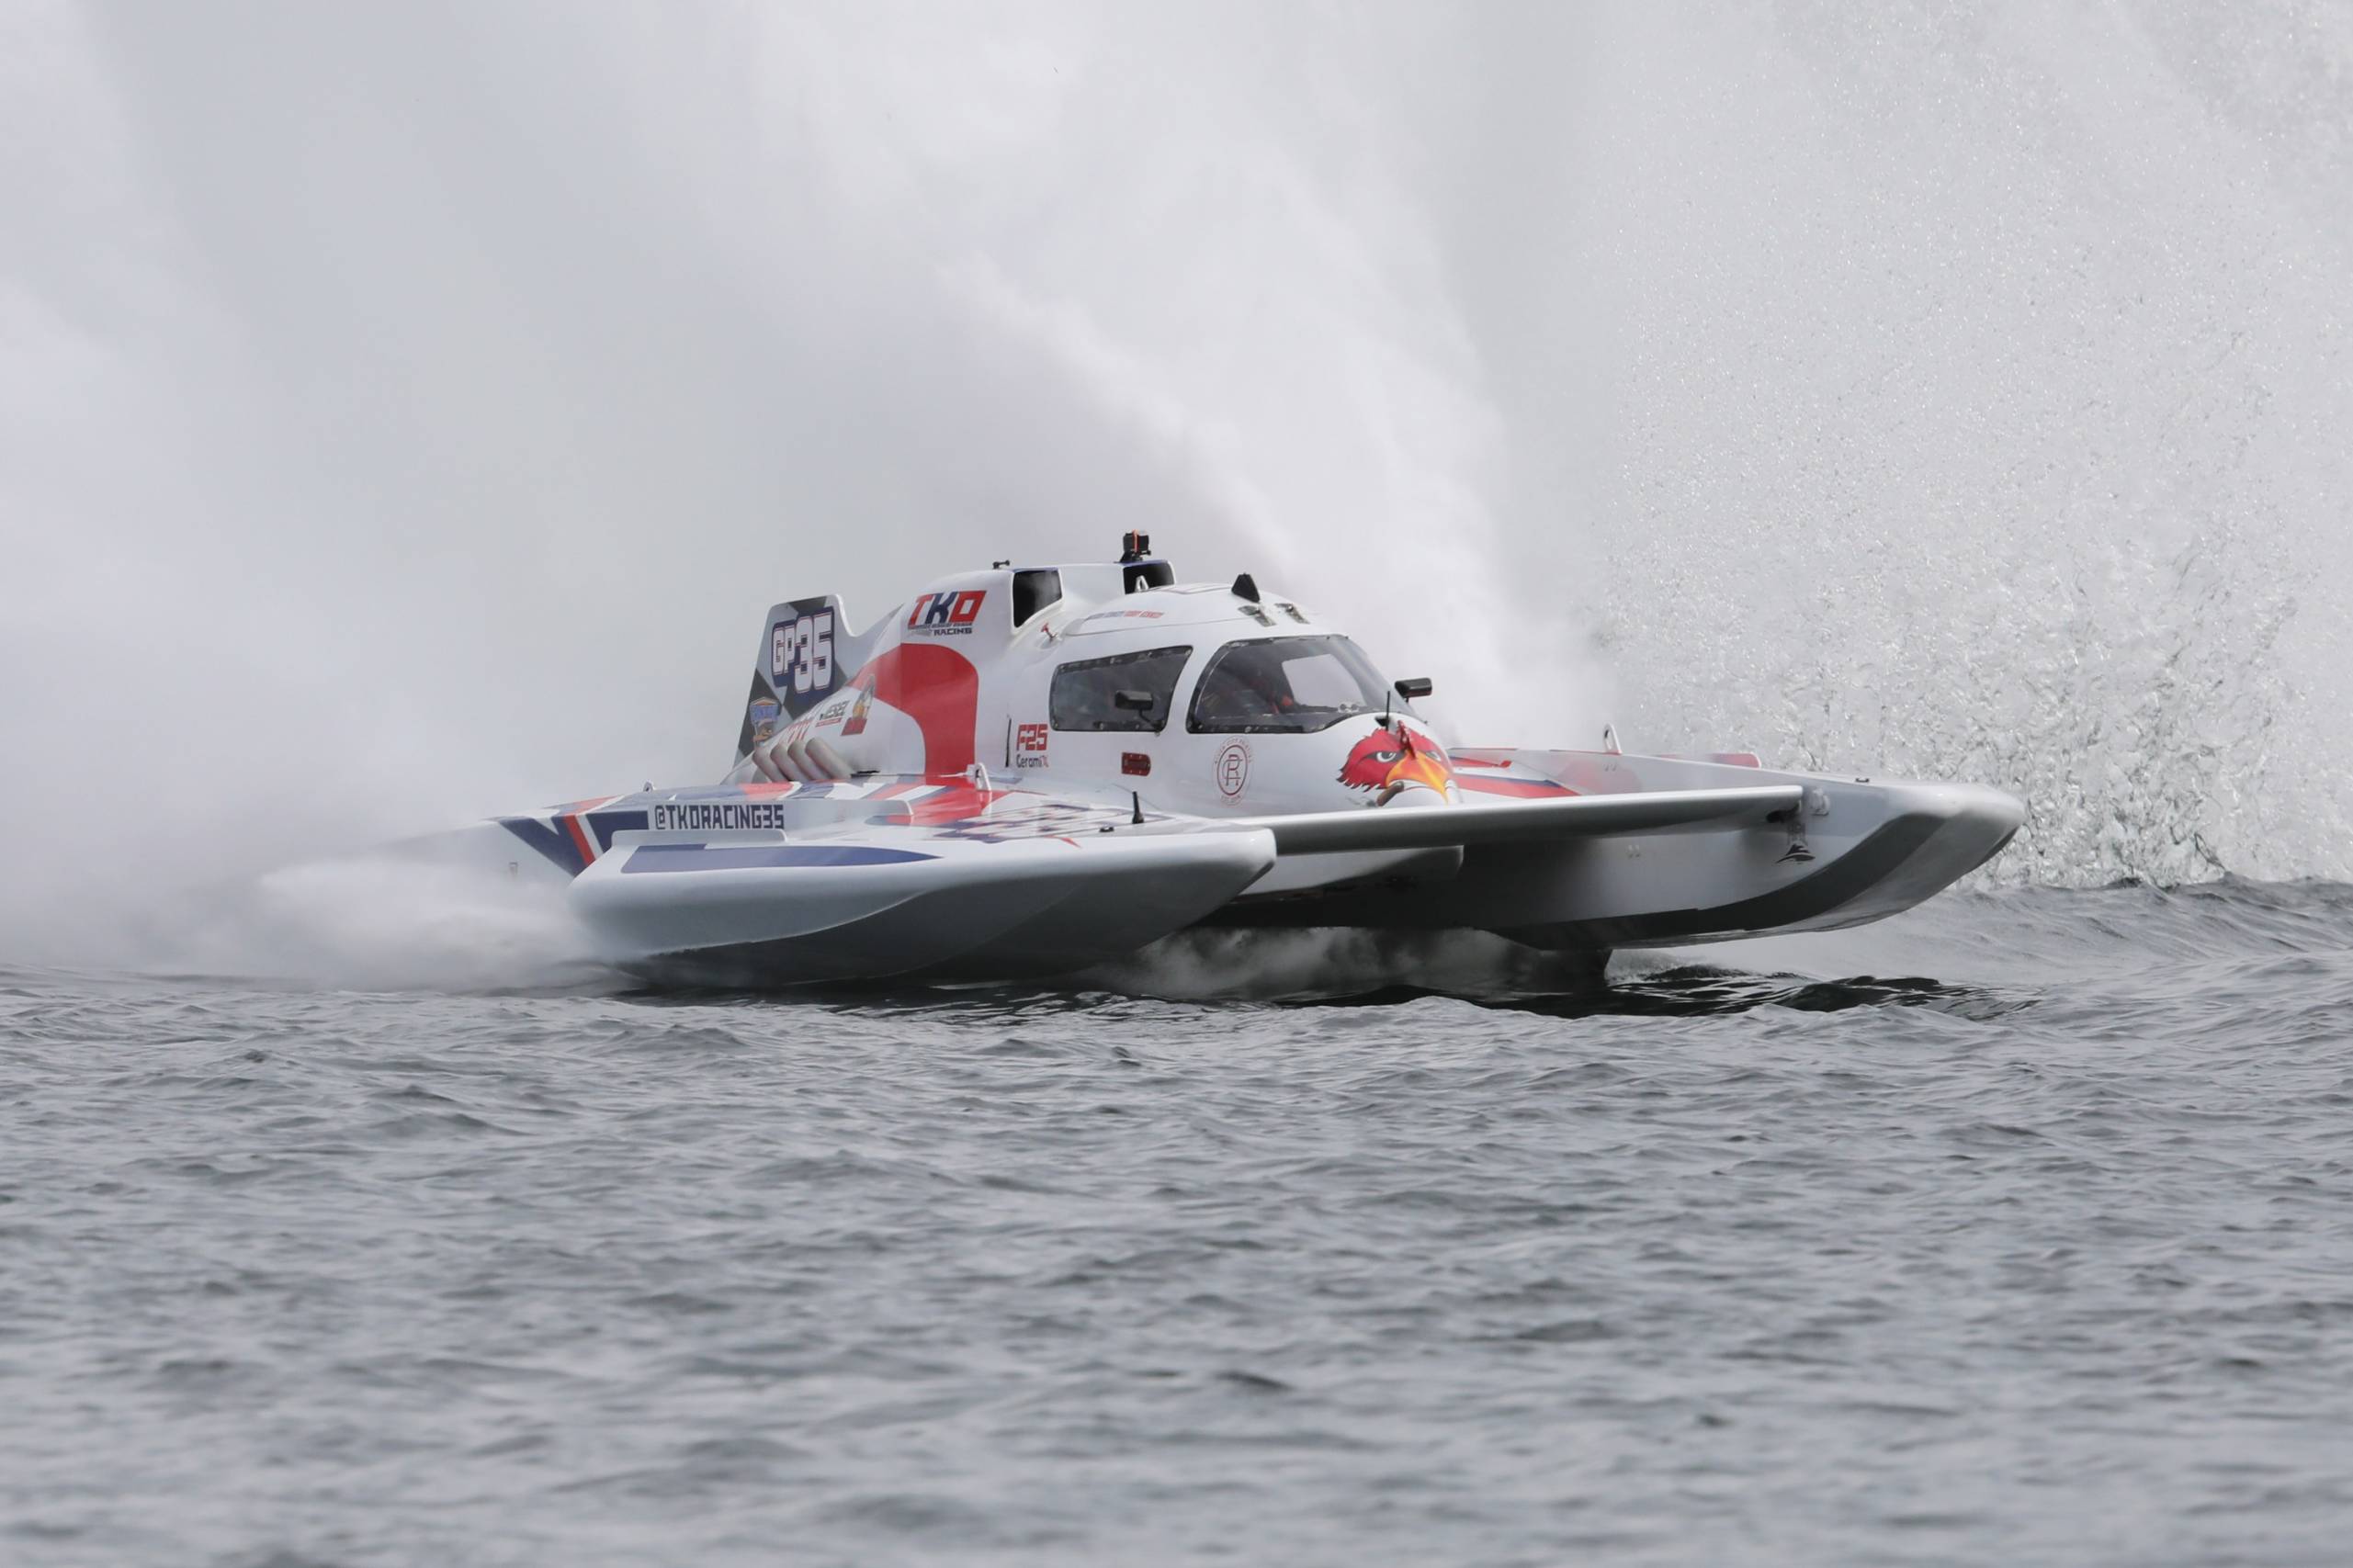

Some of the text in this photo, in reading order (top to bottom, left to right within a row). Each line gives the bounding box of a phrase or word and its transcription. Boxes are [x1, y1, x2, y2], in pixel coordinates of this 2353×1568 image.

[908, 591, 987, 629] TKO
[933, 627, 973, 636] RACING
[773, 611, 832, 694] GP35
[1016, 724, 1048, 750] F25
[655, 805, 785, 829] @TKORACING35
